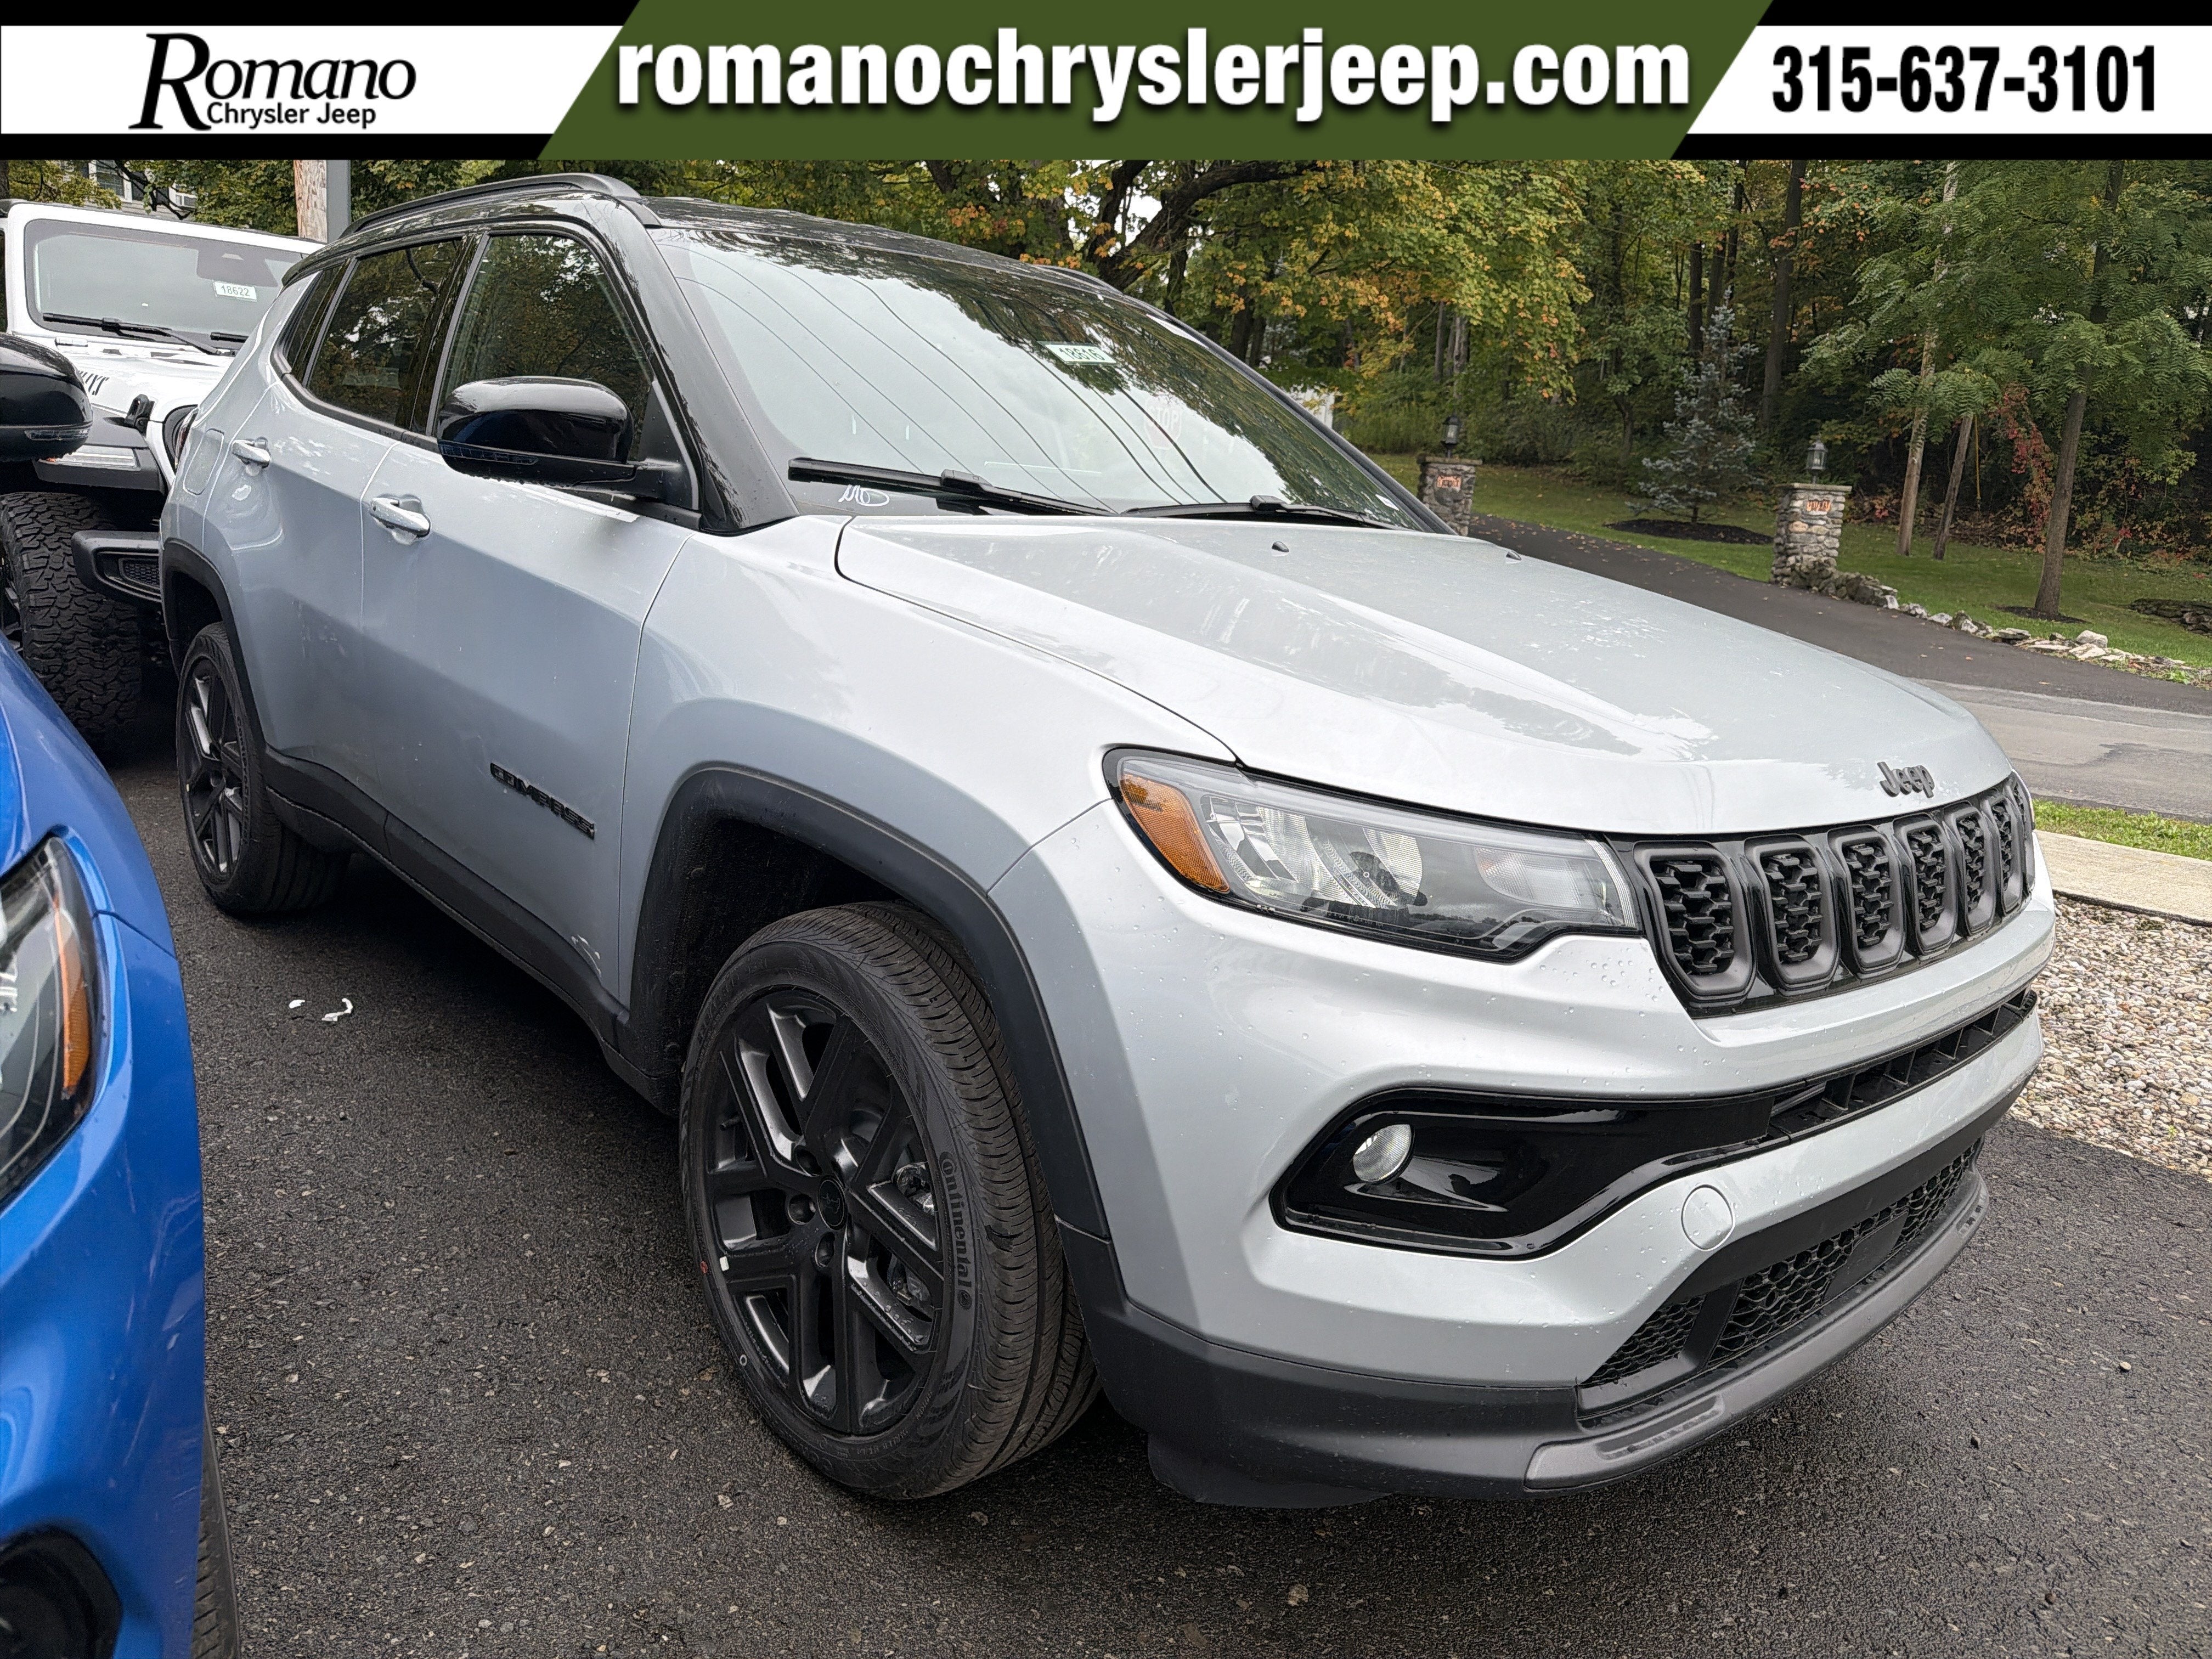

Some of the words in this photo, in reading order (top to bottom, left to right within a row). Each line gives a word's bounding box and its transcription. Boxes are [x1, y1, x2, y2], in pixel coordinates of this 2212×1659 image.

[221, 285, 250, 297] 18622
[1059, 347, 1105, 360] 18616
[1148, 405, 1181, 432] STOP
[1877, 761, 1935, 799] Jeep
[939, 1152, 972, 1288] Continental
